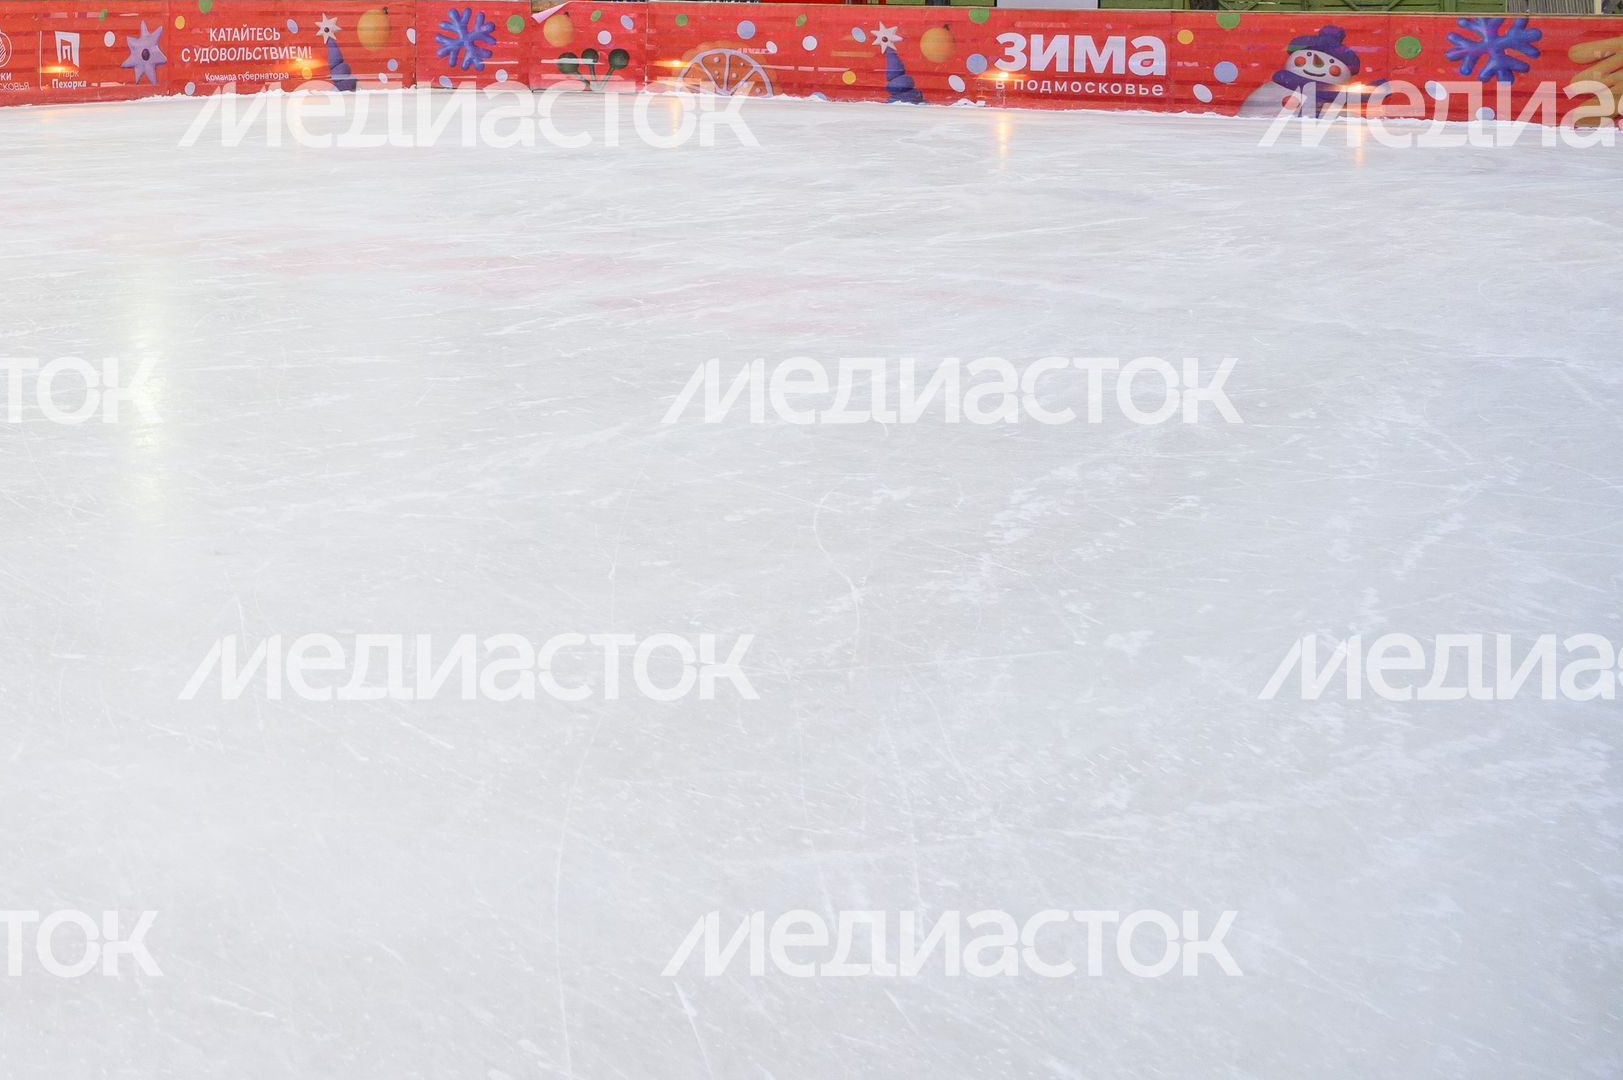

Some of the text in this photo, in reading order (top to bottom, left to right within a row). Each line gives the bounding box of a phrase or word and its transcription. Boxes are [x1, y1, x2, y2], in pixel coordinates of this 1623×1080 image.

[209, 23, 281, 41] КАТАЙТЕСЬ
[181, 46, 313, 64] С УДОВОЛЬСТВИЕМ!
[58, 70, 80, 80] Парк
[204, 71, 289, 83] Команда губернатора
[52, 78, 87, 90] Пехорка
